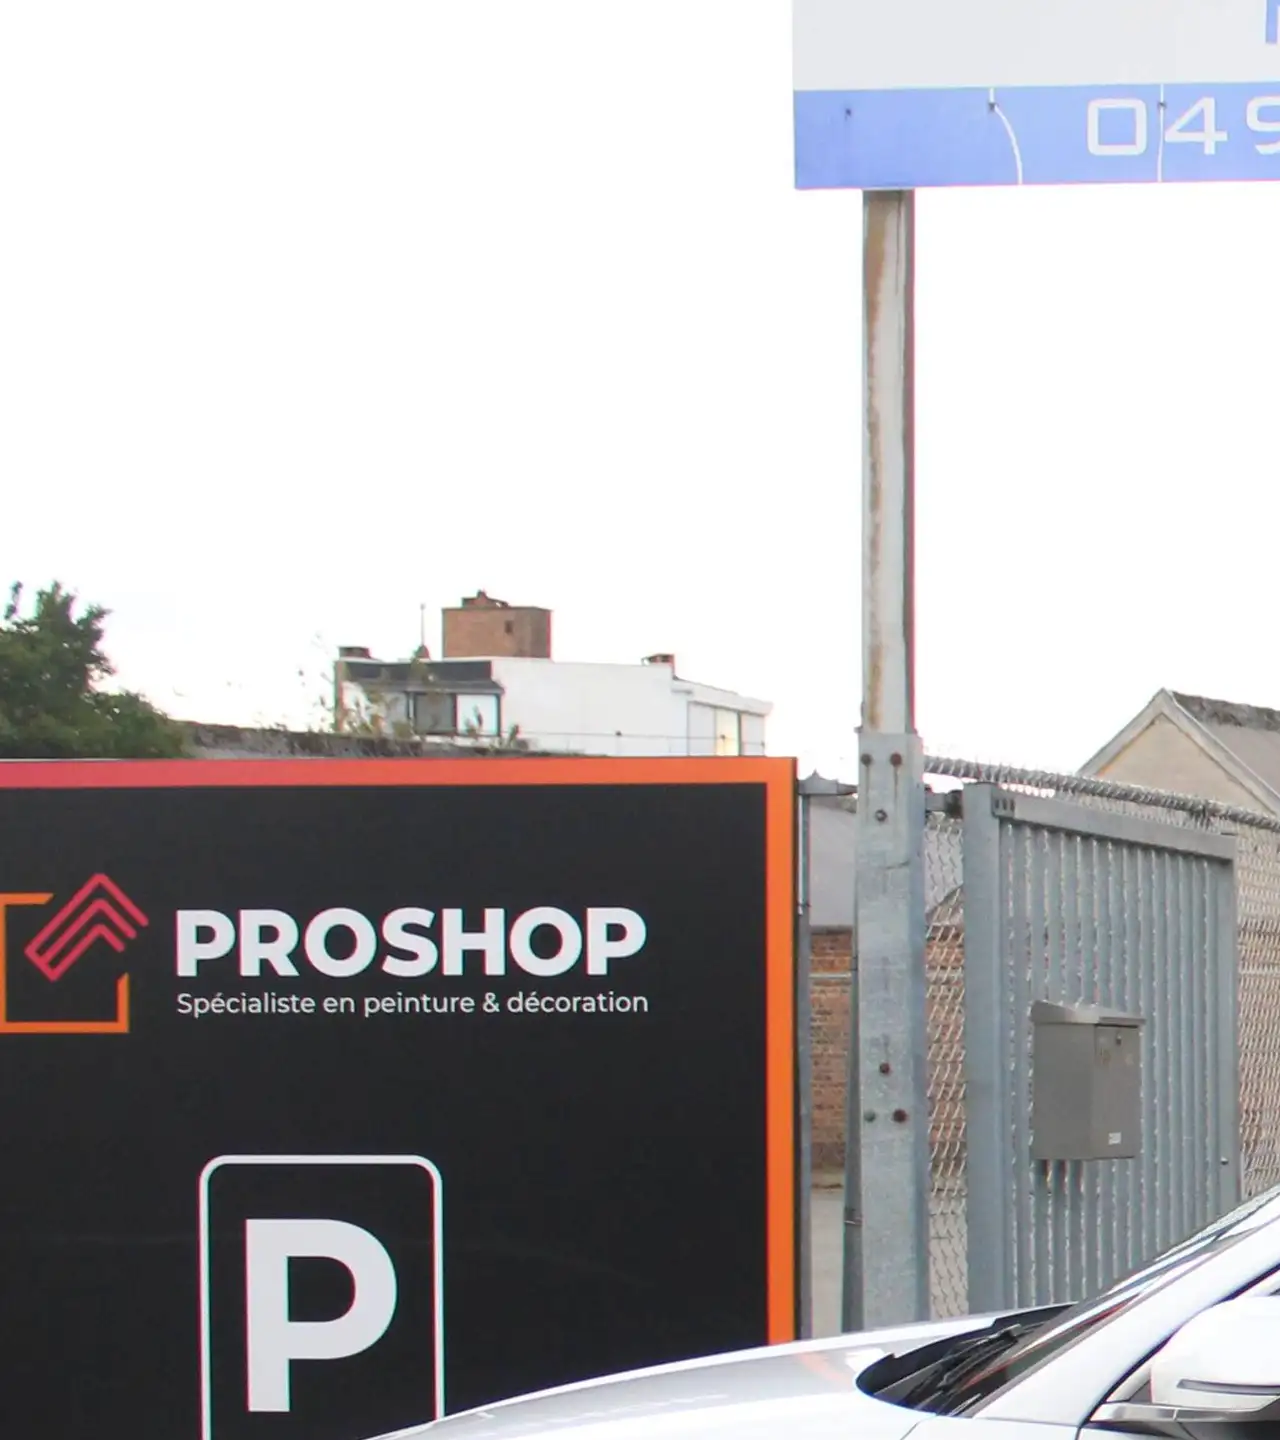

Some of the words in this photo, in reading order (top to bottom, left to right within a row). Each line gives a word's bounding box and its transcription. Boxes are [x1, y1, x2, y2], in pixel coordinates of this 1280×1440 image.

[176, 906, 647, 978] PROSHOP
[177, 991, 316, 1018] Spécialiste
[322, 996, 355, 1014] en
[363, 991, 476, 1018] peinture
[482, 991, 500, 1013] &
[506, 990, 649, 1014] décoration
[245, 1218, 397, 1413] P
